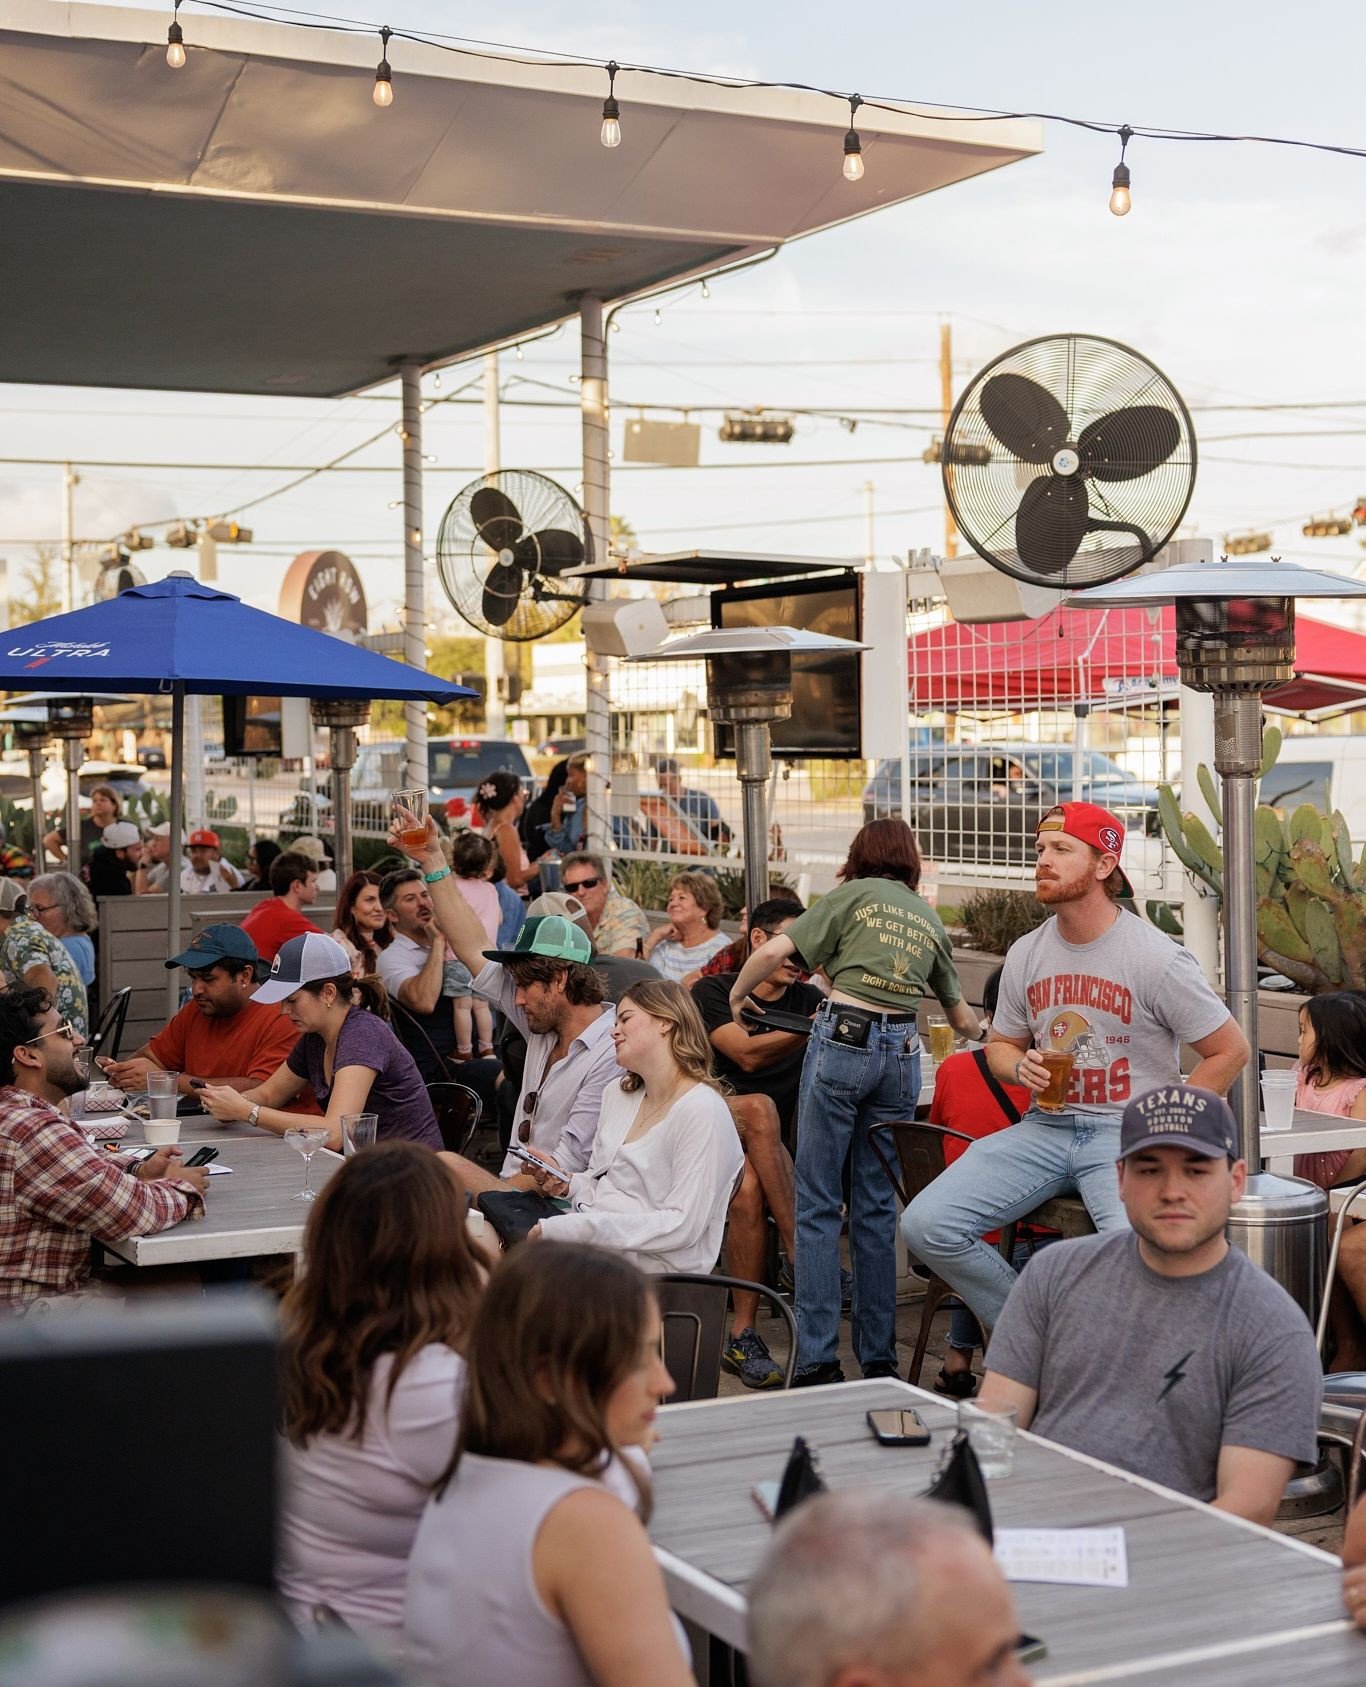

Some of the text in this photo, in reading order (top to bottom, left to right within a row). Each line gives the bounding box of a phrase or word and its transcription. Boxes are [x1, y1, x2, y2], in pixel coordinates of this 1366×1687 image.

[7, 647, 111, 657] ULTRA
[855, 903, 879, 921] JUST
[882, 903, 905, 917] LIKE
[866, 917, 934, 951] WE GET BETTER
[879, 932, 905, 949] WITH
[861, 973, 888, 989] EIGHT
[888, 982, 906, 993] ROW
[1026, 973, 1132, 1025] SAN FRANCISCO
[1105, 1035, 1131, 1045] 1946
[1136, 1089, 1207, 1115] TEXANS
[1147, 1115, 1193, 1127] HOUSTON
[1149, 1122, 1189, 1134] FOOTBALL
